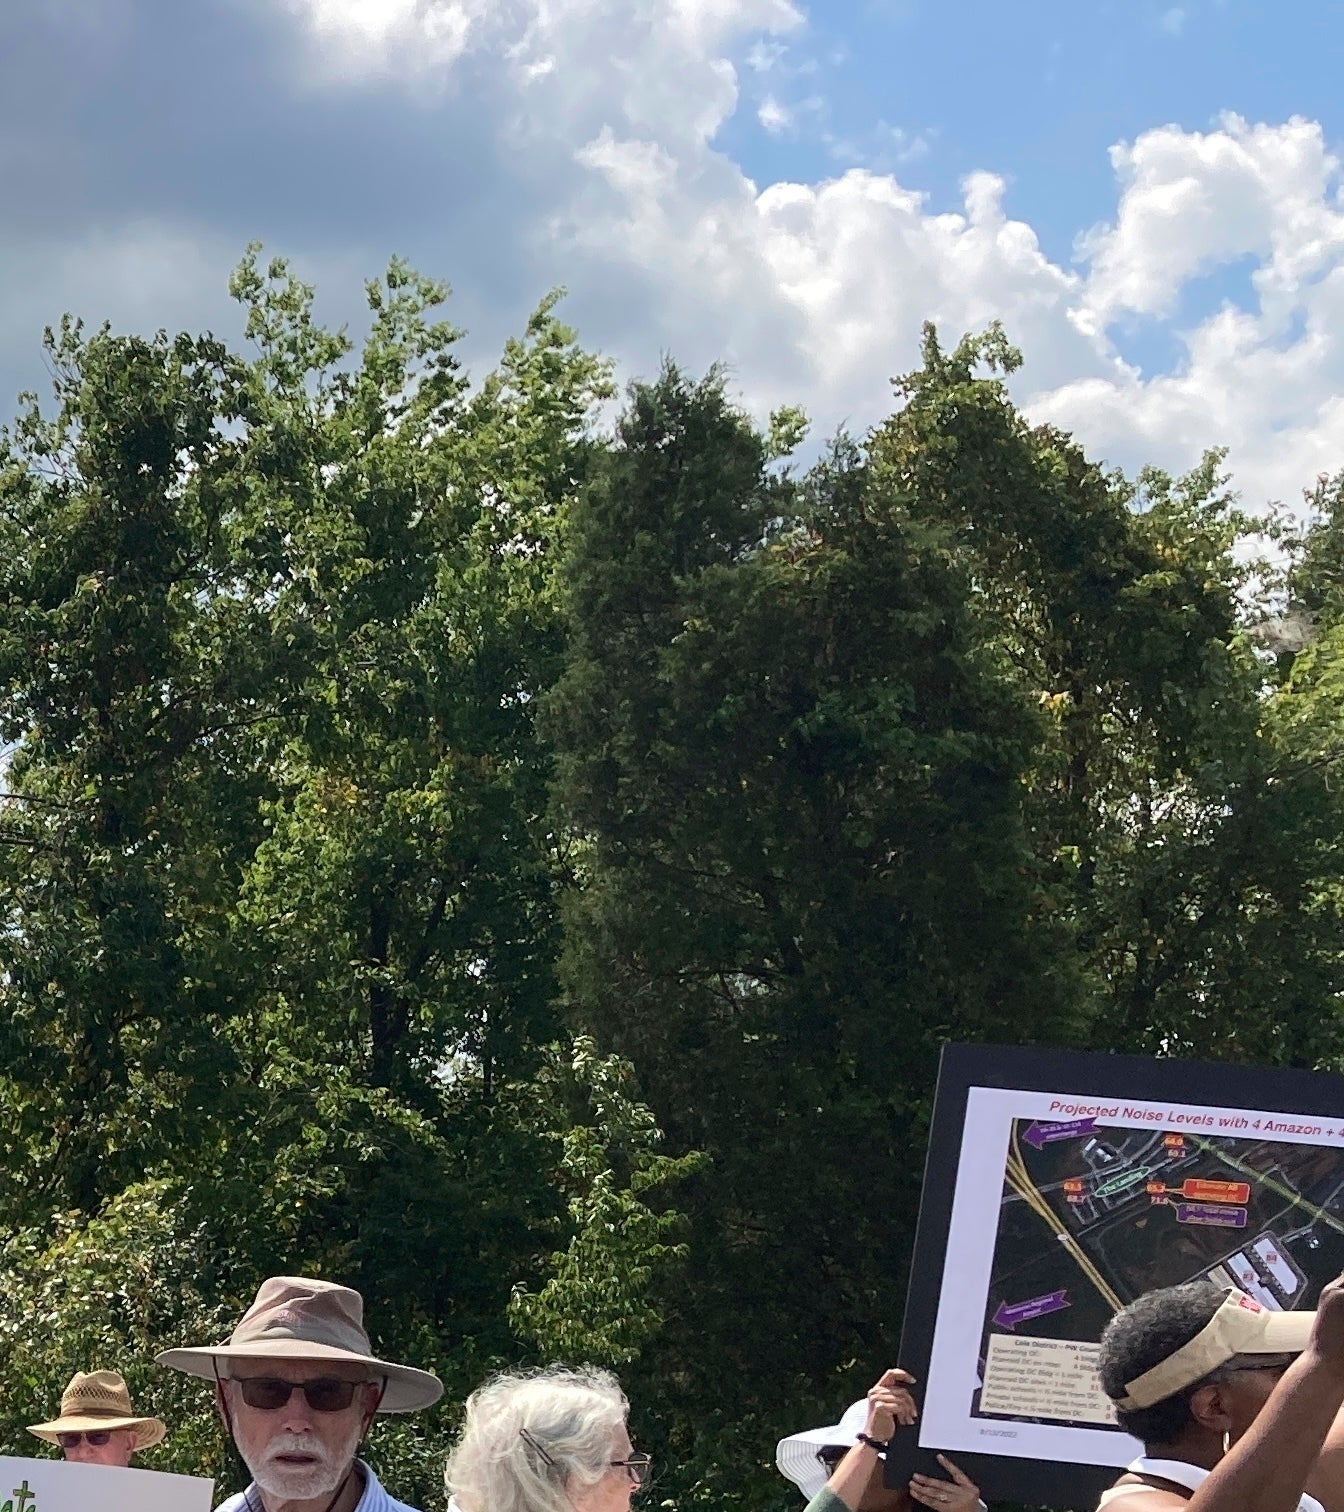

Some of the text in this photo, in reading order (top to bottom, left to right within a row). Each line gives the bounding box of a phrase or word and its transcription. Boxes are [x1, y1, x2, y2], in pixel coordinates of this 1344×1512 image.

[1049, 1100, 1119, 1118] Projected
[1122, 1107, 1163, 1121] Noise
[1168, 1110, 1214, 1126] Levels
[1218, 1116, 1248, 1129] with
[1252, 1119, 1261, 1129] 4
[1264, 1120, 1322, 1135] Amazon
